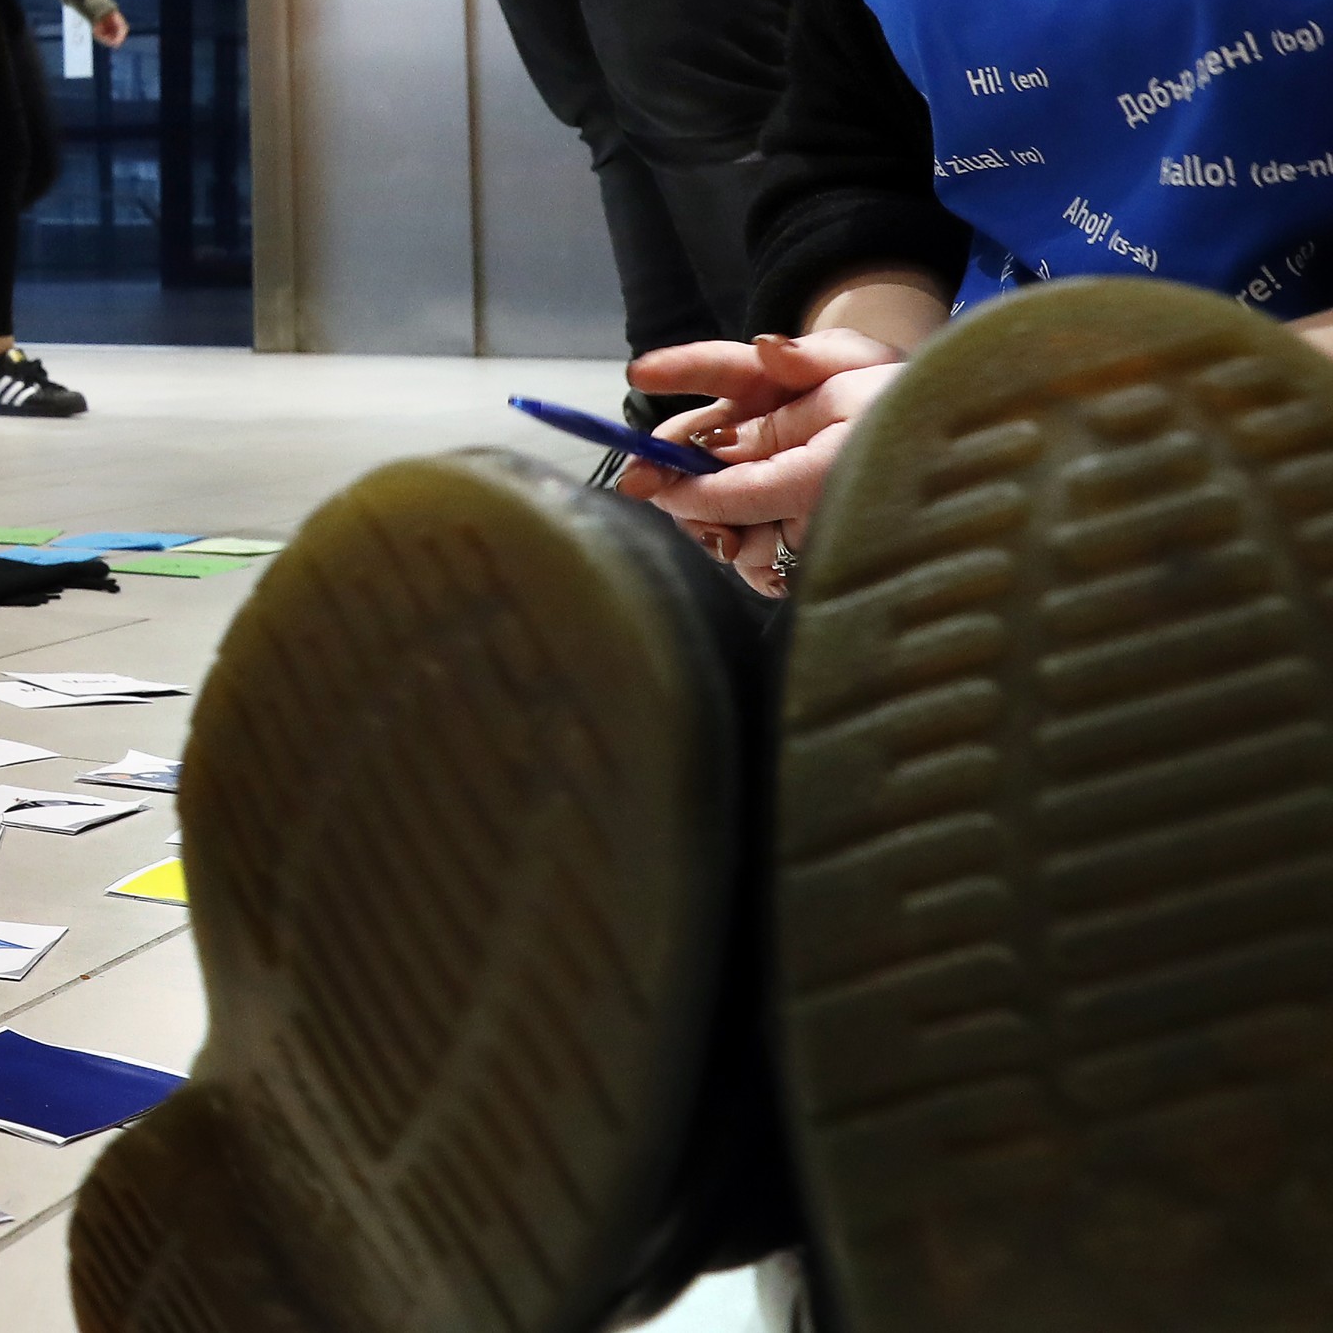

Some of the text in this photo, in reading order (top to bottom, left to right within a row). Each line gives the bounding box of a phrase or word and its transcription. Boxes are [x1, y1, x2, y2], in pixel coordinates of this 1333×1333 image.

[1270, 19, 1325, 56] (bg)
[965, 66, 1050, 97] Hi! (en)
[944, 148, 1010, 175] ziua!
[1009, 146, 1046, 167] (ro)
[1062, 196, 1113, 245] Ahoj!
[1107, 228, 1159, 272] (cs-sk)
